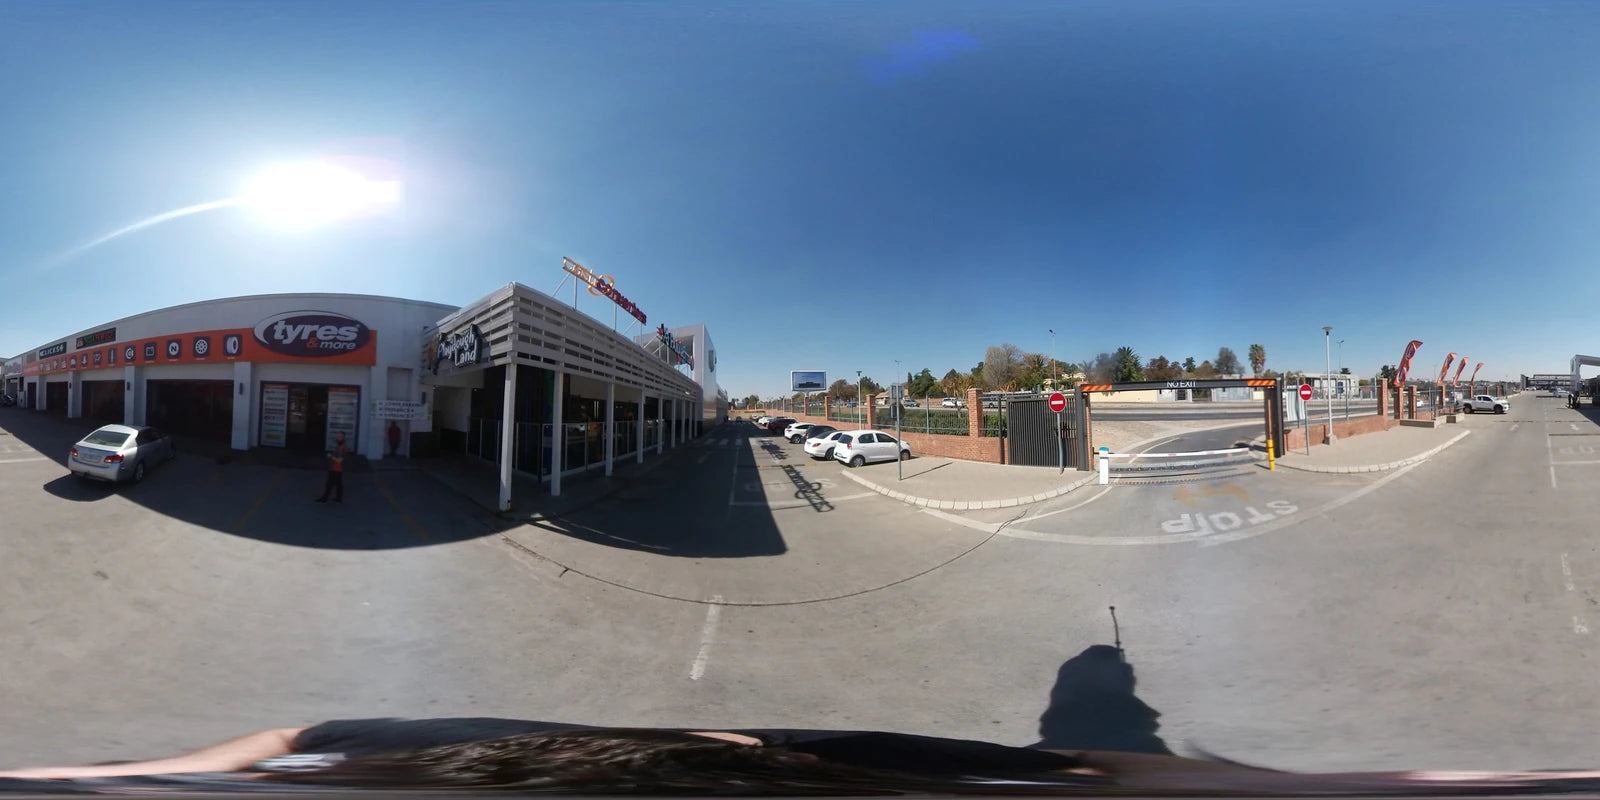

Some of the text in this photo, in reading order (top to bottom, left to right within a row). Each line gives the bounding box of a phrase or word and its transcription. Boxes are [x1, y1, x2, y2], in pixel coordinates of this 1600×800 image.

[273, 320, 359, 344] tyres
[306, 337, 356, 350] & more
[454, 339, 477, 366] Land
